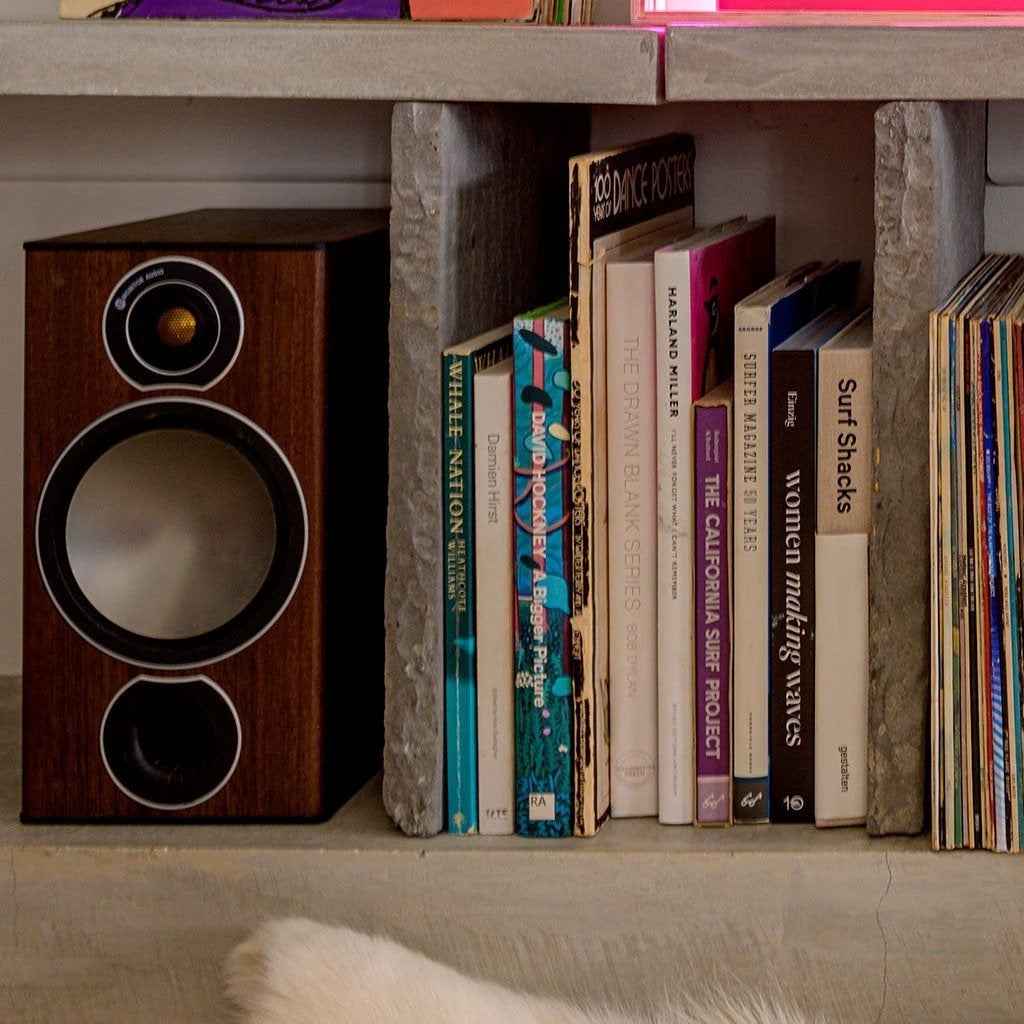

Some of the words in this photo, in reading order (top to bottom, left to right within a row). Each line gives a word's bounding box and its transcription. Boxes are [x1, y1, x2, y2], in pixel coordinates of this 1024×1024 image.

[613, 163, 648, 216] DANCE
[667, 286, 679, 360] HARLAND
[623, 335, 640, 375] THE
[743, 353, 758, 407] SURFER
[448, 360, 463, 437] WHALE
[623, 381, 640, 457] DRAWN
[668, 365, 679, 419] MILLER
[784, 390, 798, 429] Einzig
[837, 378, 858, 427] Surf
[487, 433, 501, 489] Damien
[532, 410, 547, 465] DAVID
[743, 412, 758, 484] MAGAZINE
[448, 449, 464, 533] NATION
[623, 463, 641, 533] BLANK
[705, 473, 721, 508] THE
[743, 489, 758, 504] 50
[836, 432, 858, 514] Shacks
[487, 491, 500, 525] Hirst
[532, 469, 547, 559] HOCKNEY
[743, 509, 758, 553] YEARS
[785, 469, 802, 565] women
[447, 540, 457, 601] WILLIAMS
[457, 539, 467, 613] HEATHCOTE
[532, 569, 547, 583] A
[623, 538, 642, 612] SERIES
[704, 513, 721, 625] CALIFORNIA
[530, 585, 548, 644] Bigger
[627, 623, 638, 652] BOB
[778, 570, 808, 666] making
[533, 645, 549, 709] Picture
[627, 654, 638, 699] DYLAN
[704, 628, 721, 673] SURF
[704, 678, 721, 760] PROJECT
[785, 669, 802, 748] waves
[838, 745, 851, 794] gestalten
[530, 795, 547, 807] RA
